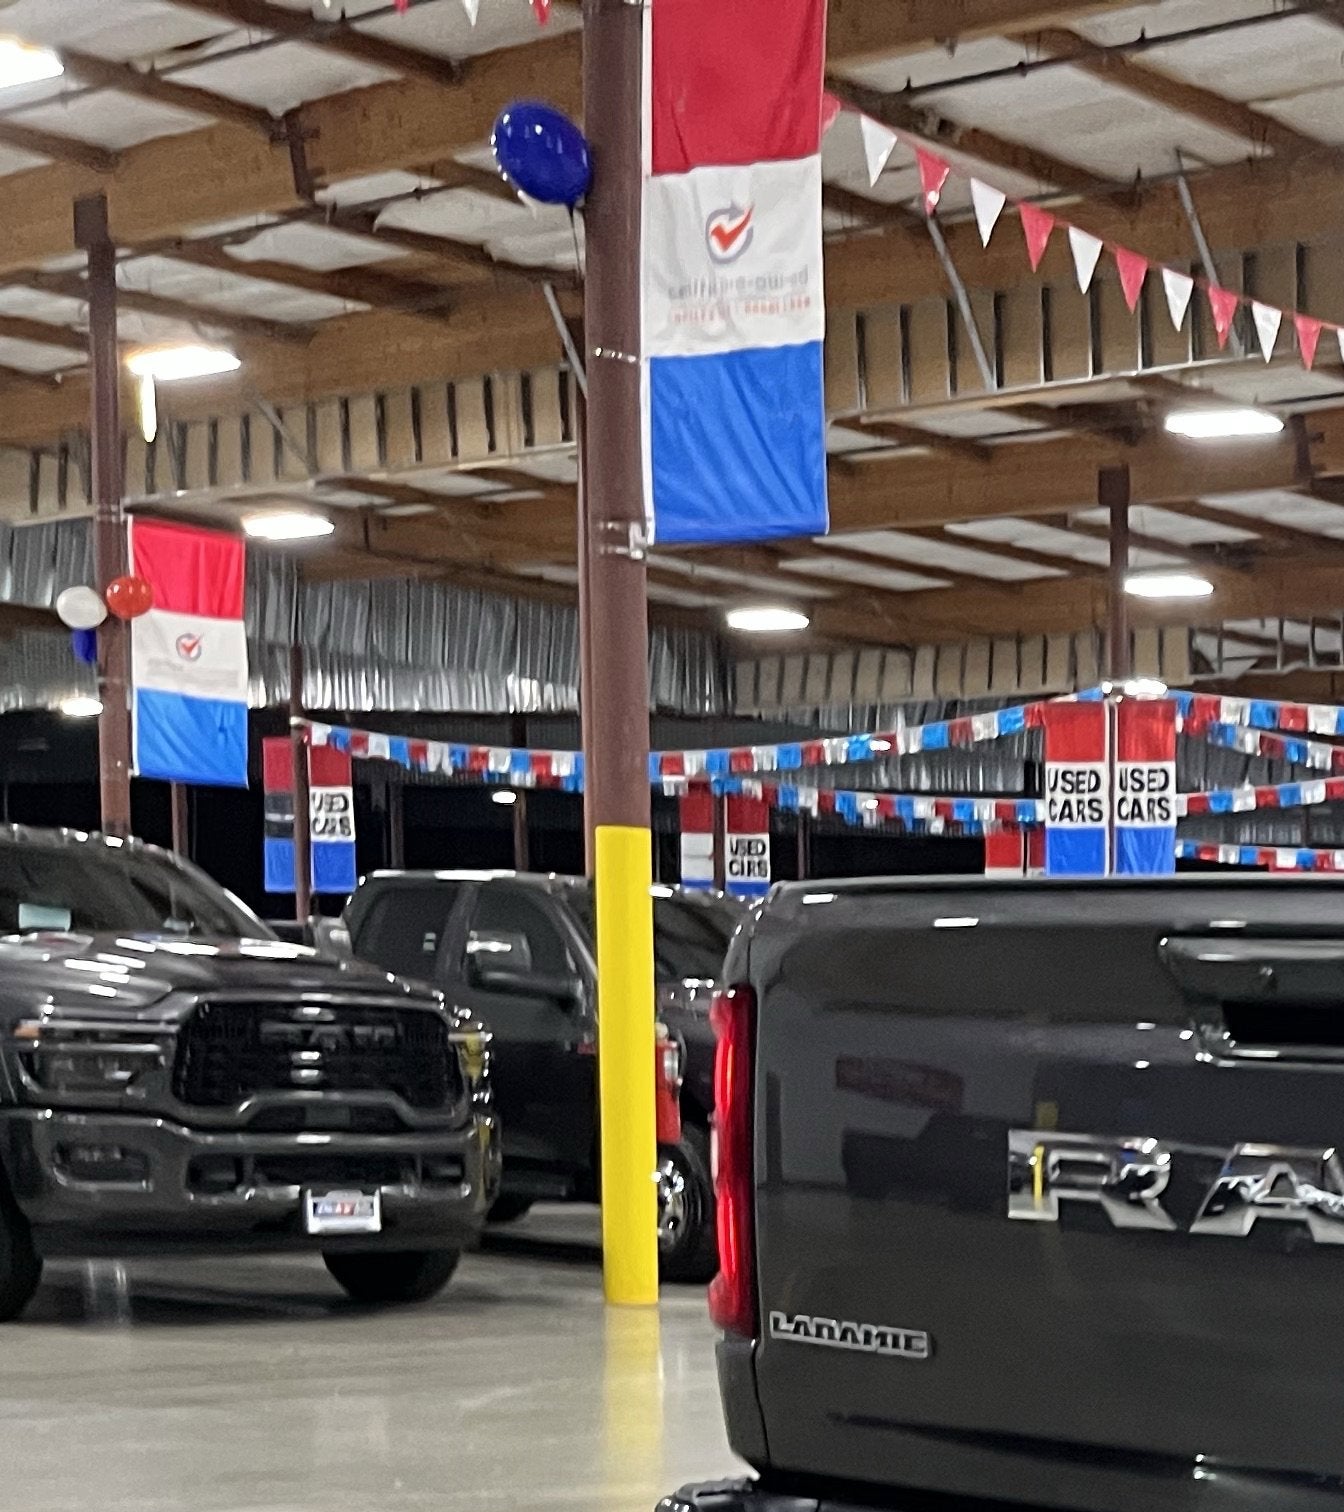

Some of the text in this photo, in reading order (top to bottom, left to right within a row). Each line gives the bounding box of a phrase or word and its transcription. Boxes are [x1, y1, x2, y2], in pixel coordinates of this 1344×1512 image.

[1048, 768, 1100, 794] USED
[1119, 768, 1169, 792] USED
[1049, 798, 1103, 822] CARS
[1117, 796, 1170, 821] CARS
